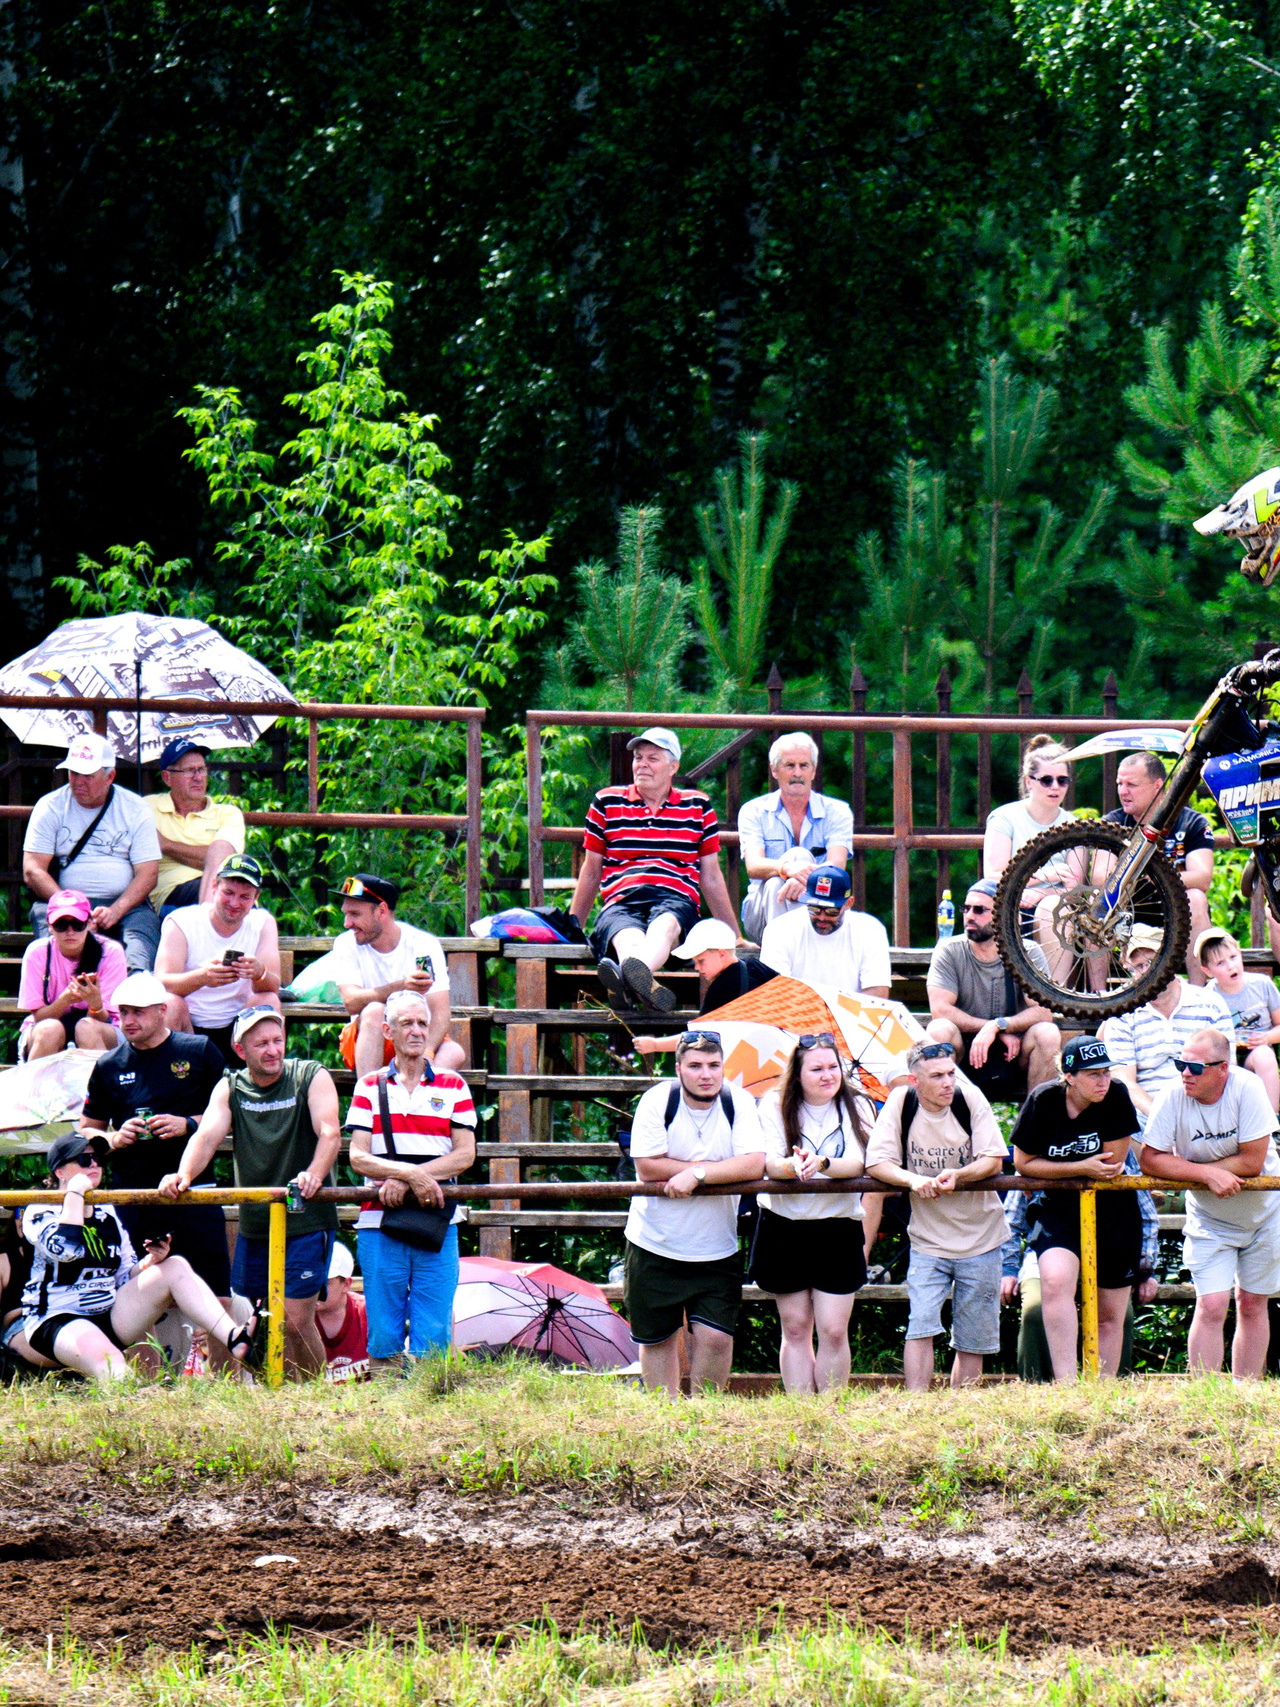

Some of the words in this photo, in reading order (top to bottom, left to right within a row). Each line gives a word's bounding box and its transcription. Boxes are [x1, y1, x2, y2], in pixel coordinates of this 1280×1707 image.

[1231, 747, 1280, 765] SALMONICA
[911, 1141, 924, 1154] ke
[927, 1146, 955, 1157] care
[911, 1156, 947, 1169] urself
[65, 1283, 87, 1293] PRO
